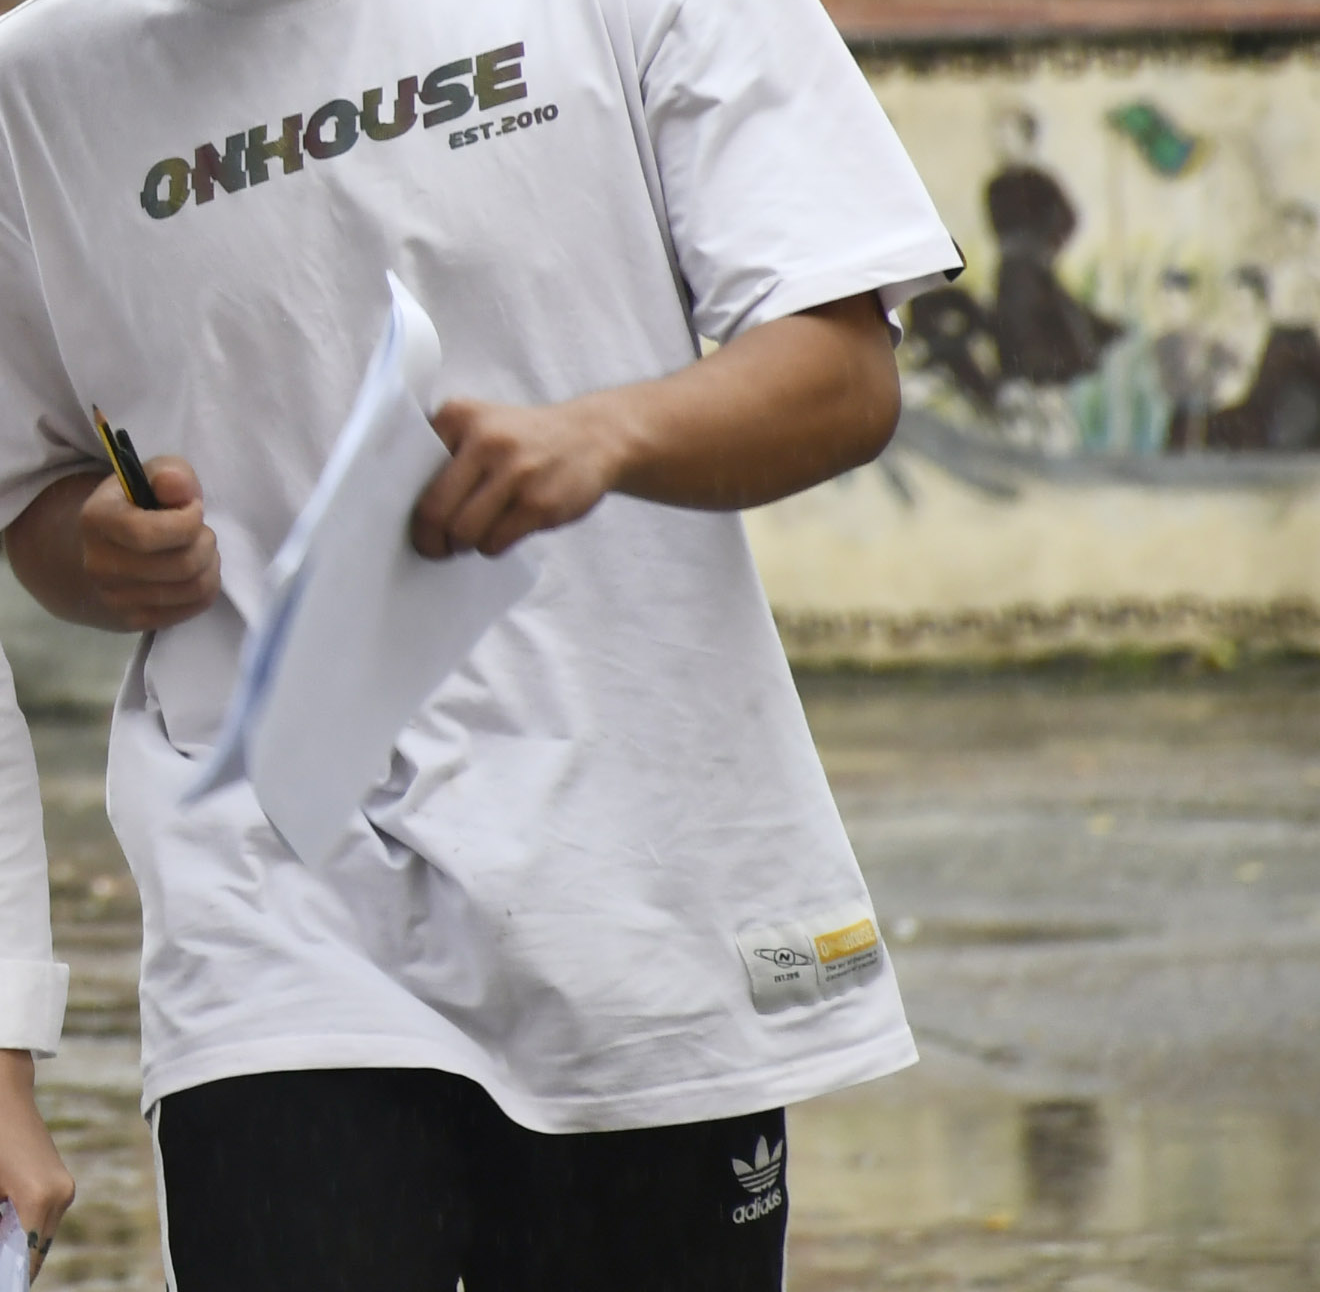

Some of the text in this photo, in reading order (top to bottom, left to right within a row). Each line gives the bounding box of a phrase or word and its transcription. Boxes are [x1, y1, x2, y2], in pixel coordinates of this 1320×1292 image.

[140, 41, 527, 219] ONHOUSE
[449, 104, 558, 150] EST.2010
[733, 1188, 781, 1223] adidas
